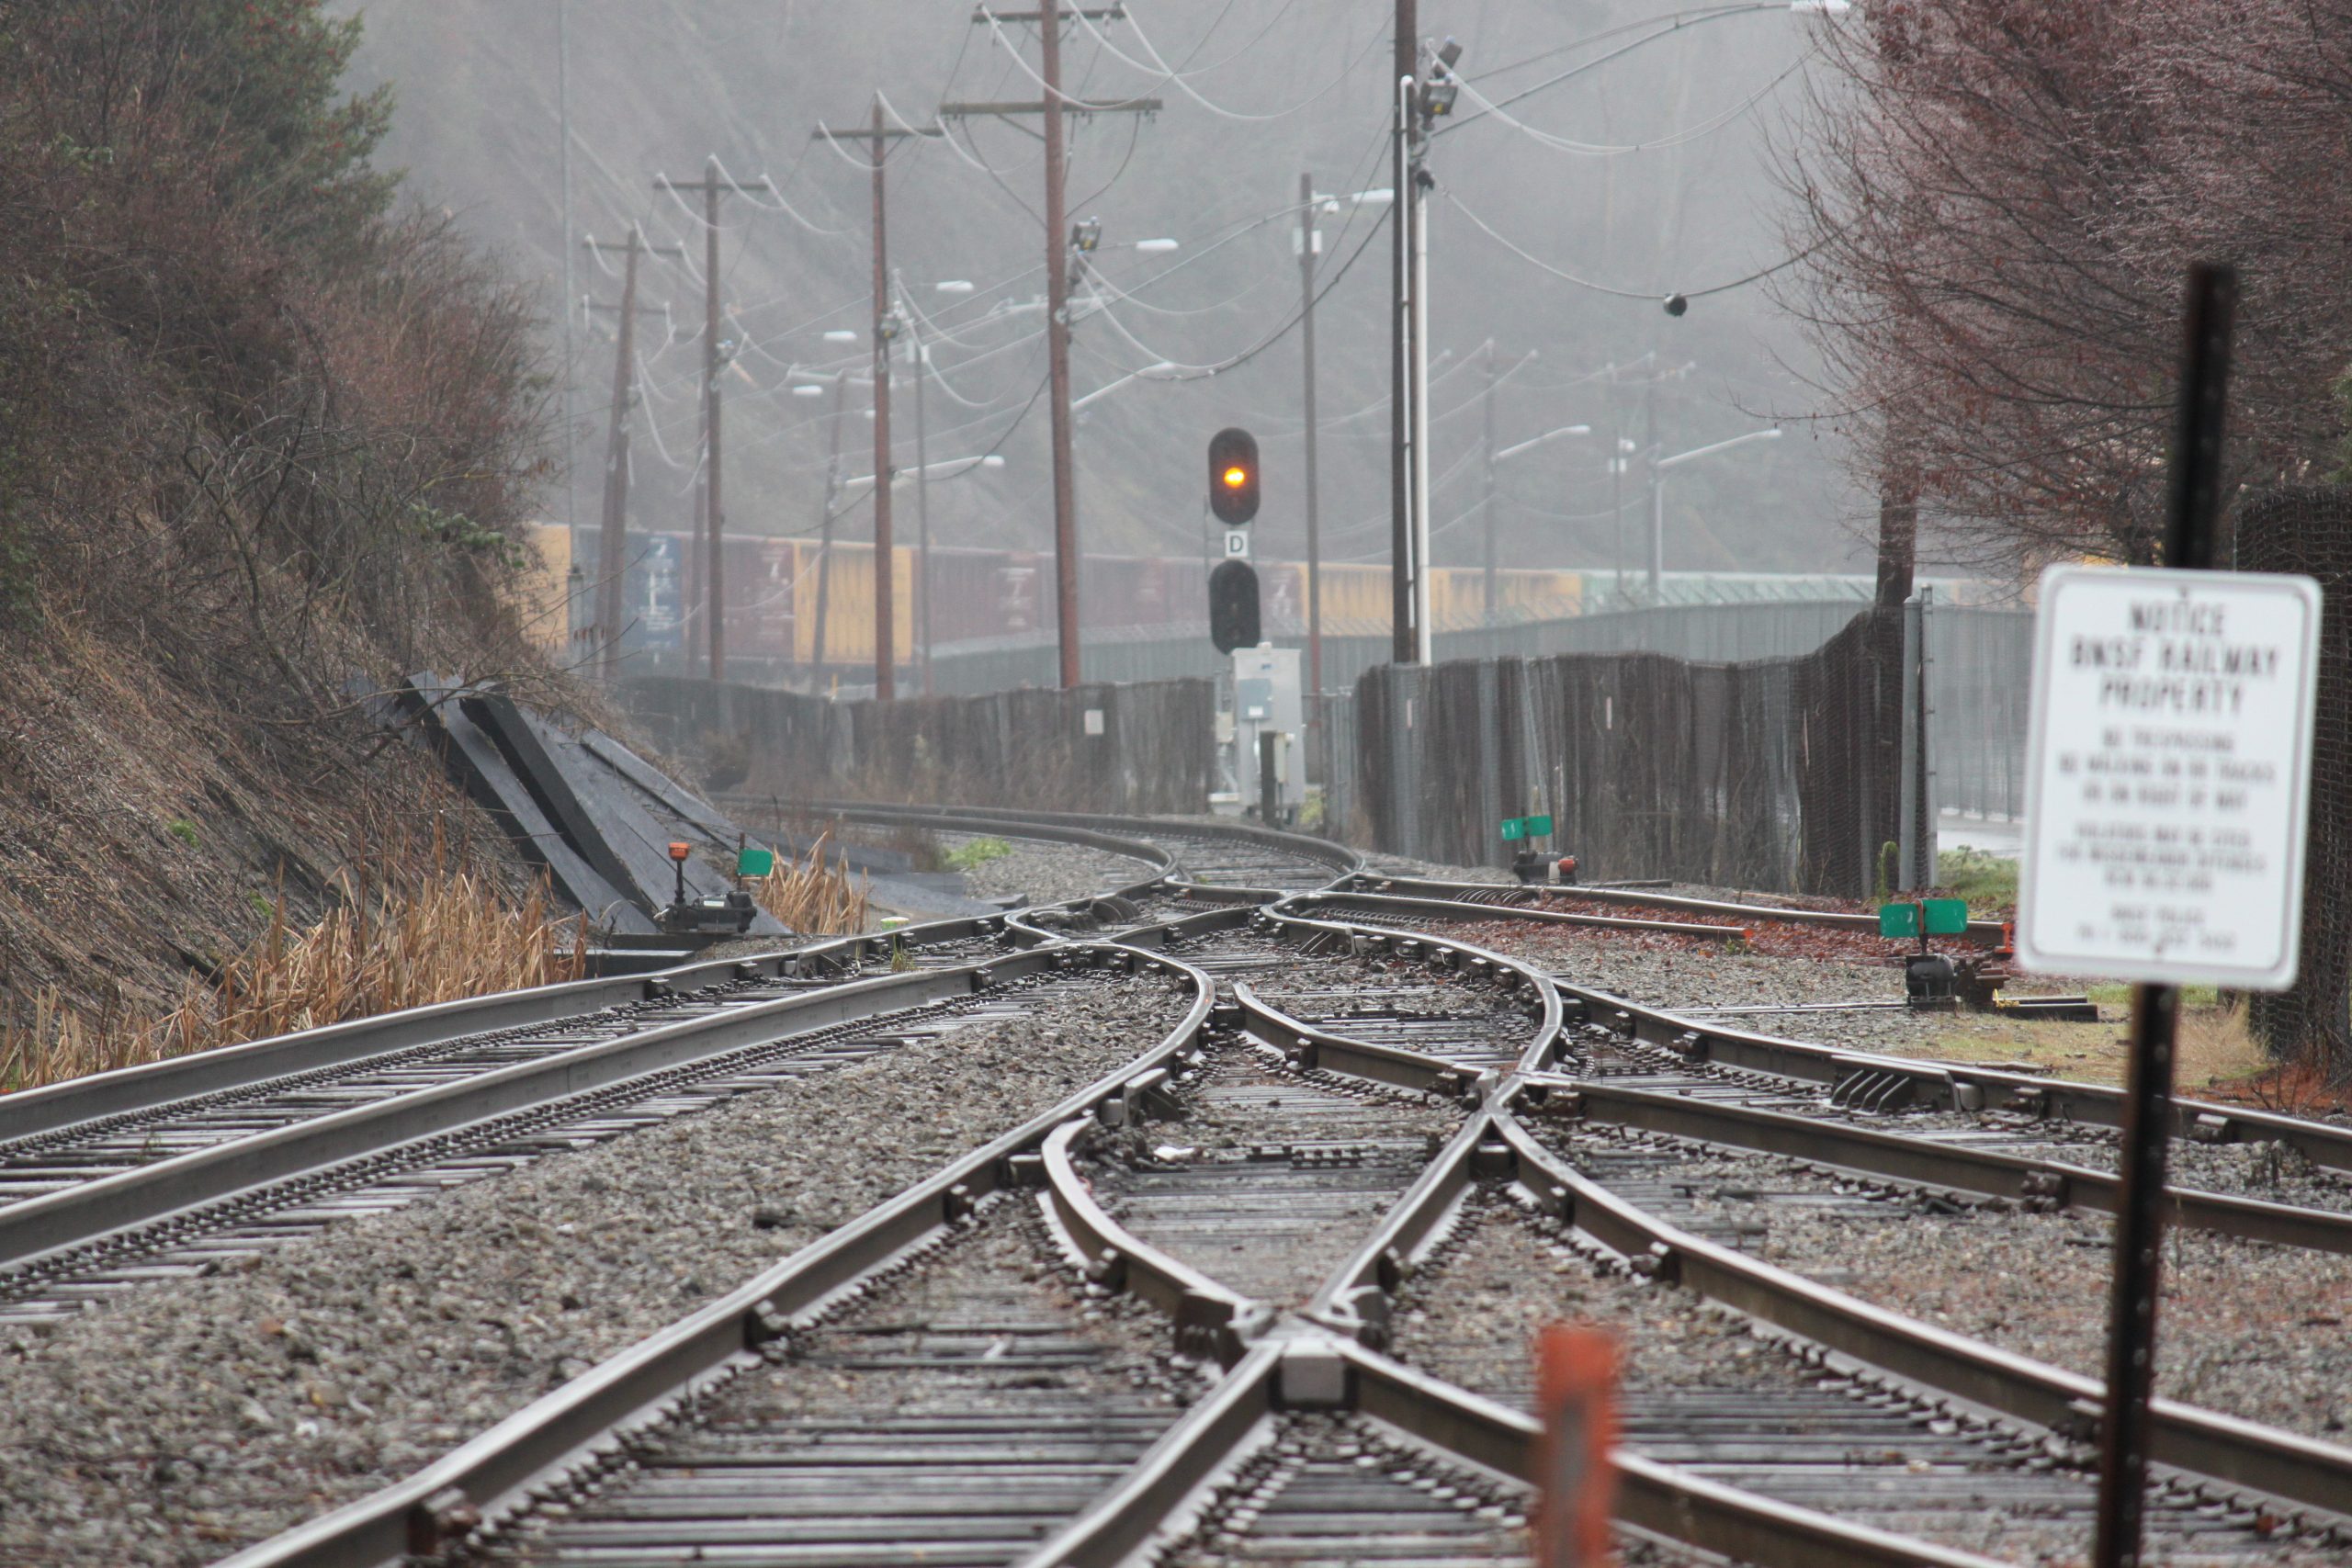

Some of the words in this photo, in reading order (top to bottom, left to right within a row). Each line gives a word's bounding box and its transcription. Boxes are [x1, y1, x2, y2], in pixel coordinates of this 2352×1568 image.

[1229, 536, 1244, 552] D
[2129, 602, 2227, 636] NOTICE
[2159, 641, 2280, 677] RAILWAY
[2100, 677, 2244, 715] PROPERTY
